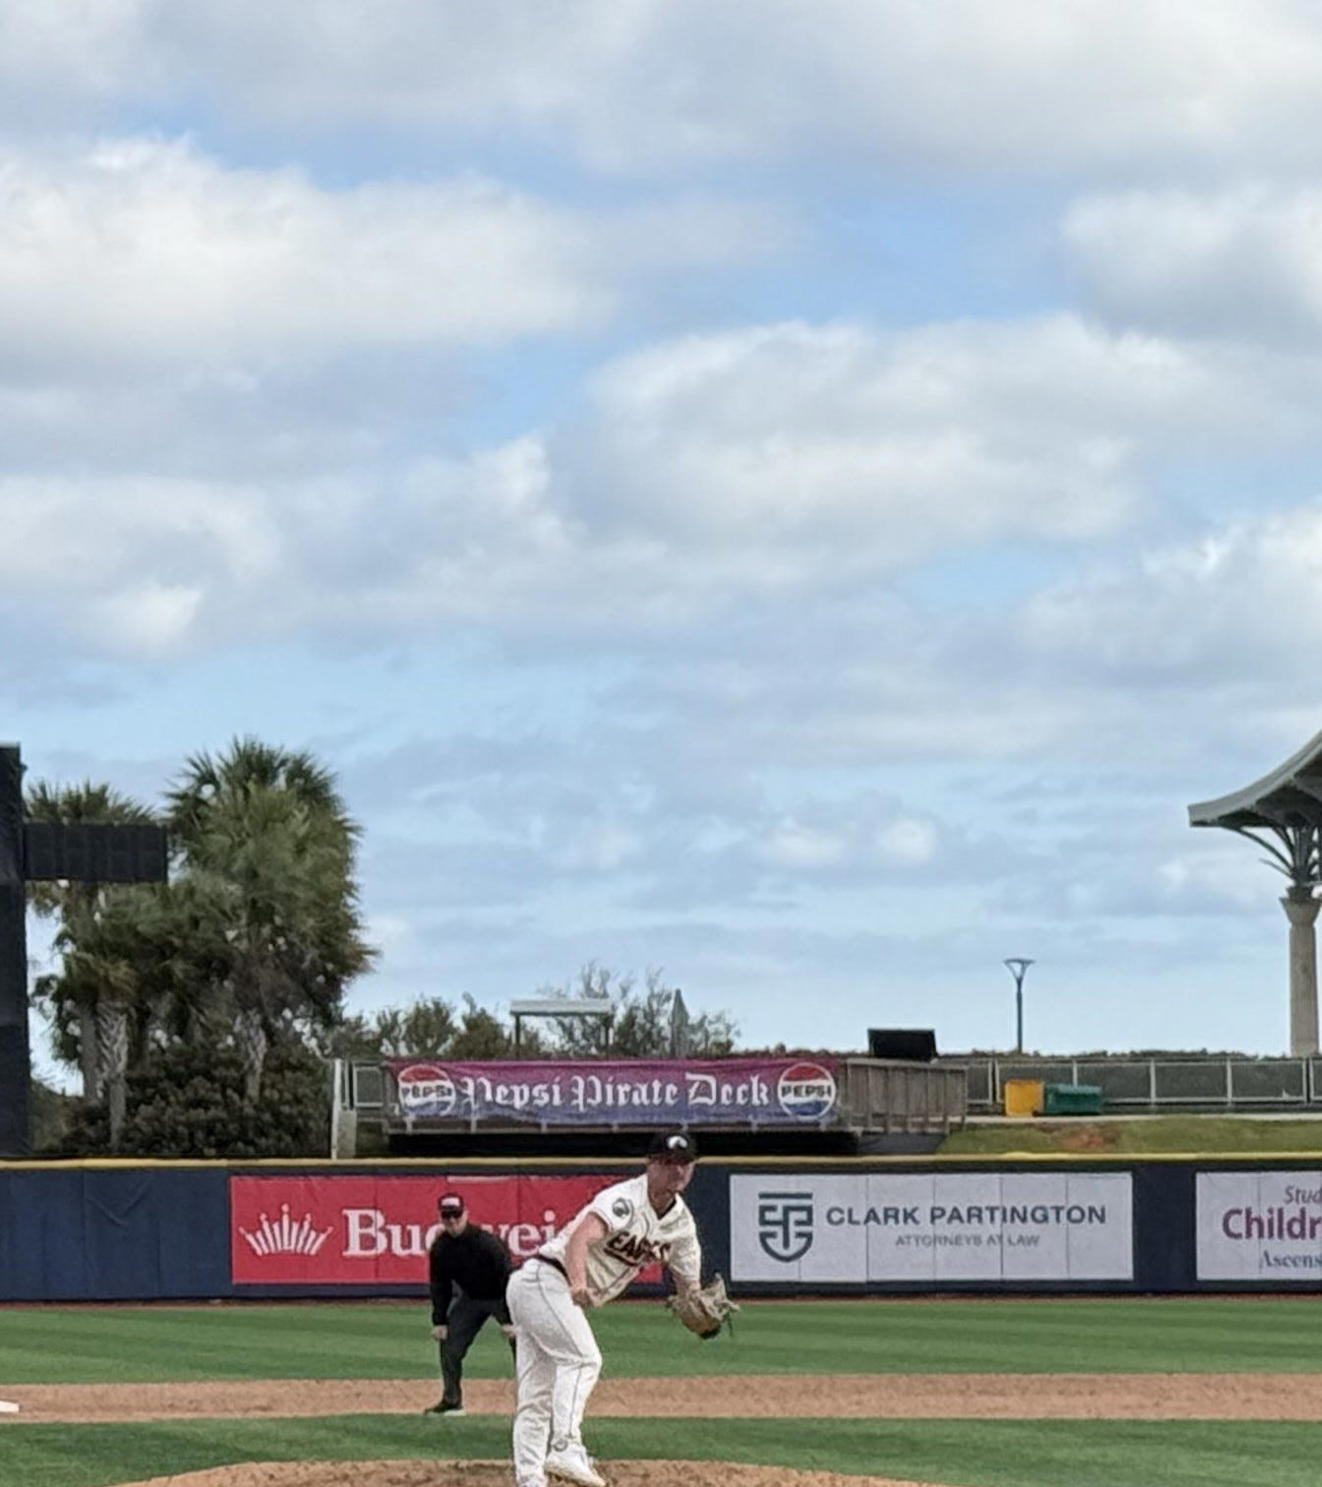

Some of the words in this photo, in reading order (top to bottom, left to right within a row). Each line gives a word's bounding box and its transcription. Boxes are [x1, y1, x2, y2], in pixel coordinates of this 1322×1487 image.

[686, 1073, 769, 1105] Deck
[826, 1206, 920, 1225] CLARK
[929, 1205, 1106, 1225] PARTINGTON
[895, 1234, 983, 1247] ATTORNEYS
[1008, 1234, 1040, 1247] LAW
